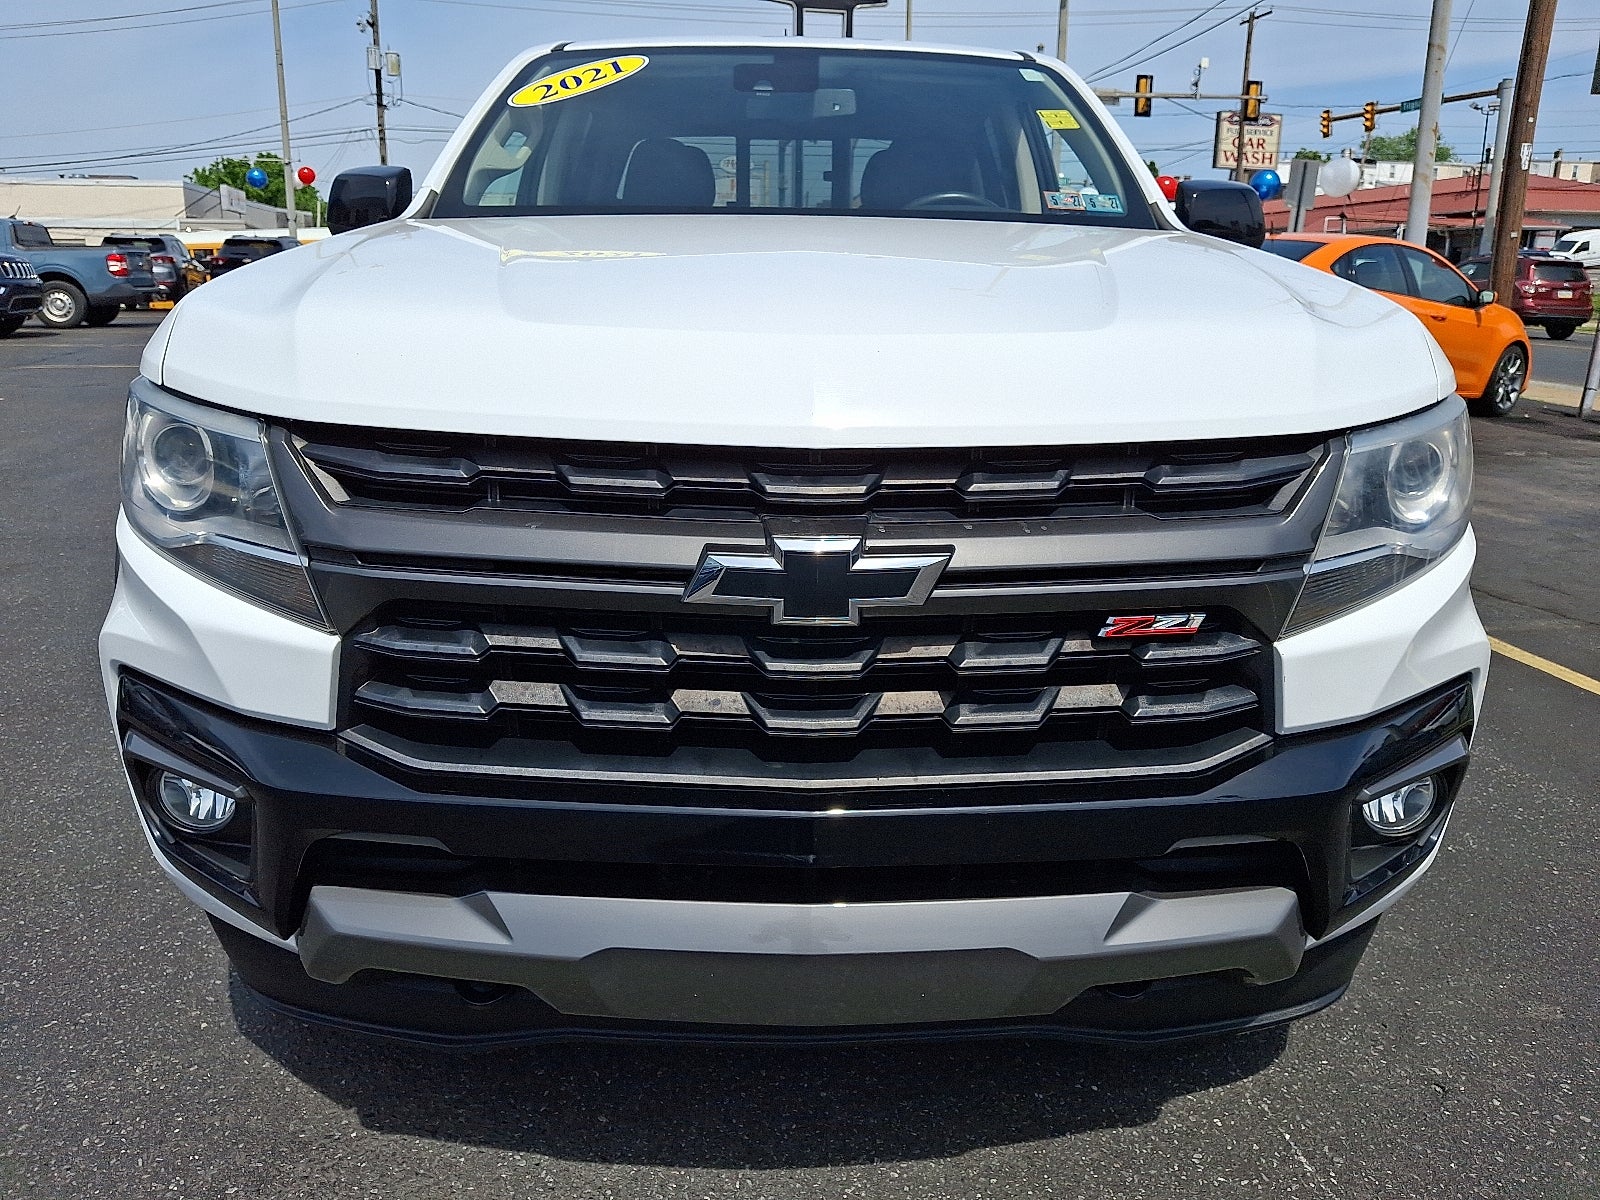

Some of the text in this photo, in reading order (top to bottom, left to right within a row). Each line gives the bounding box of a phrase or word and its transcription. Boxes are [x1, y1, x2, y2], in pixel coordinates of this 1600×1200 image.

[532, 60, 629, 100] 2021
[1232, 136, 1266, 149] CAR
[1224, 149, 1273, 165] WASH
[1097, 613, 1207, 638] Z71
